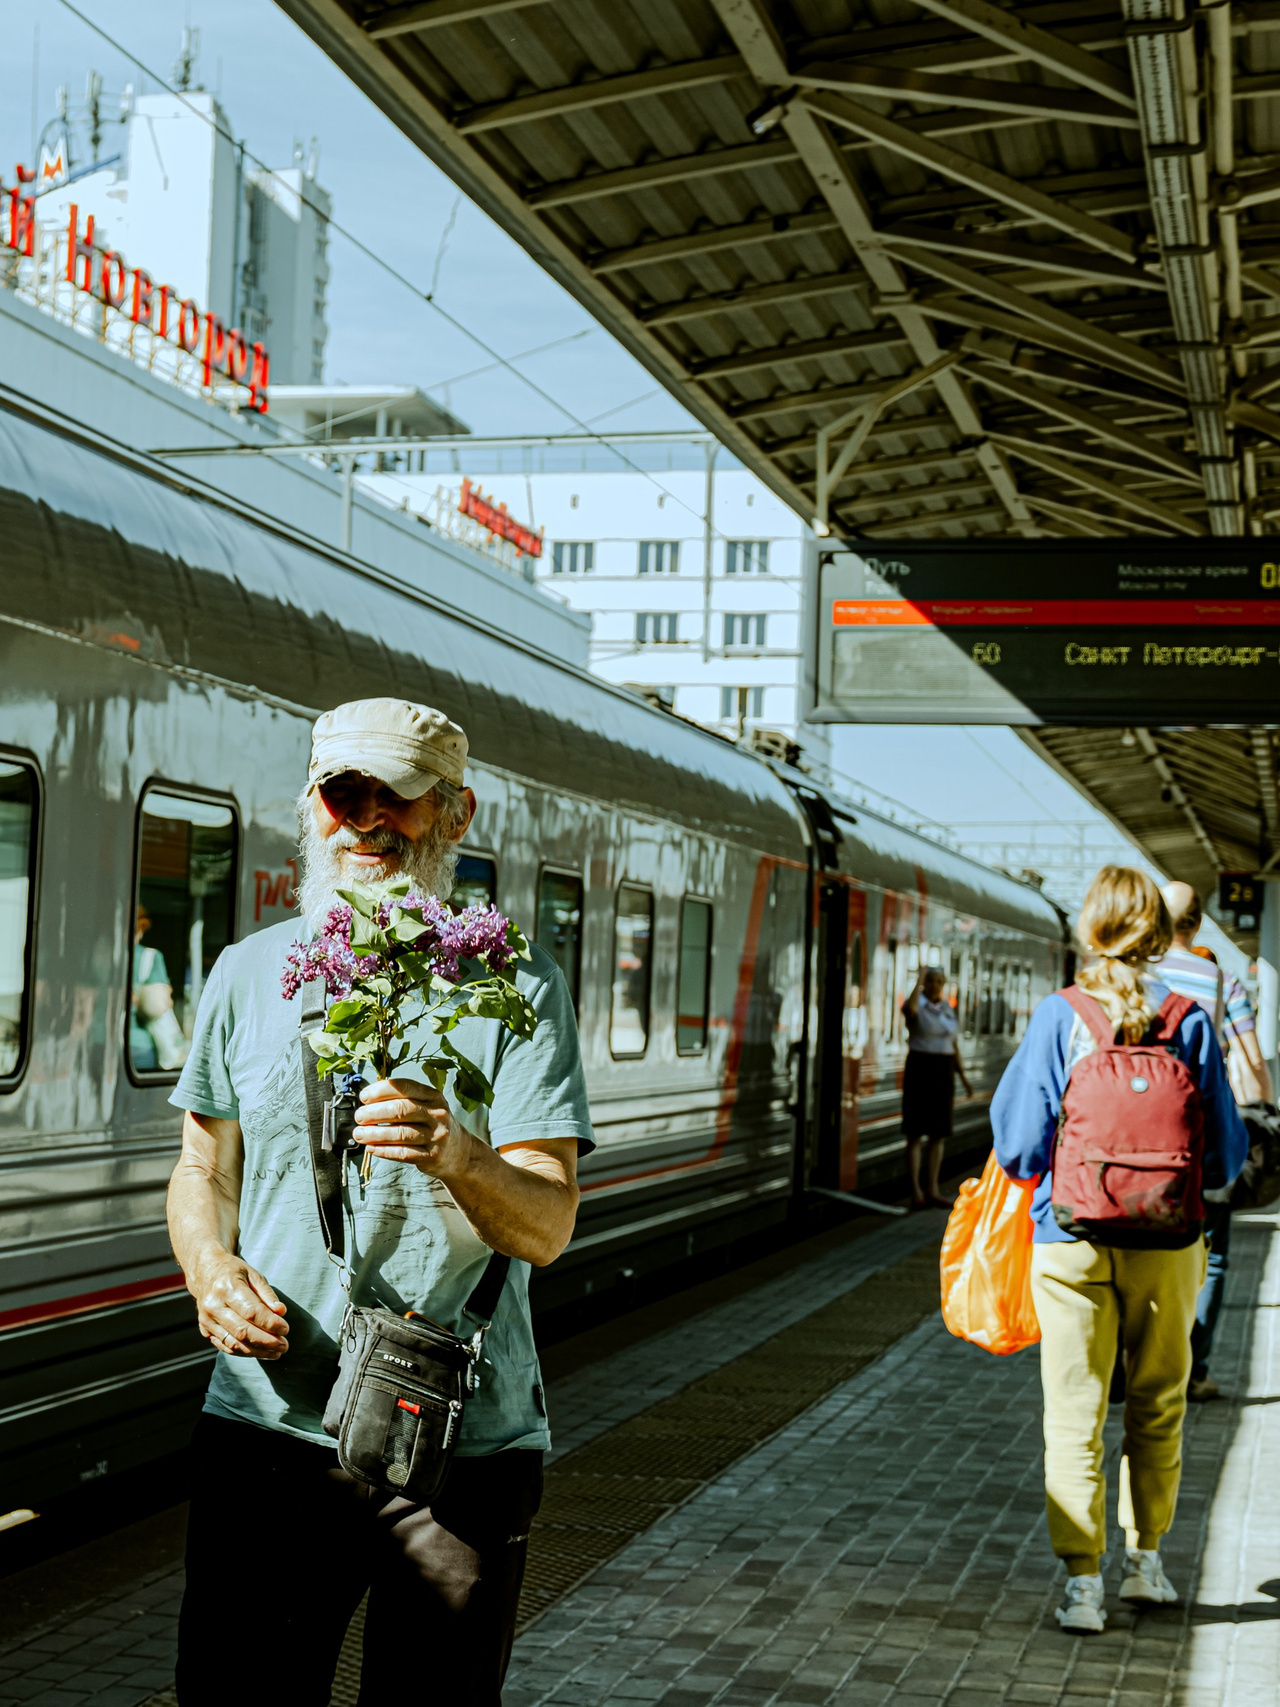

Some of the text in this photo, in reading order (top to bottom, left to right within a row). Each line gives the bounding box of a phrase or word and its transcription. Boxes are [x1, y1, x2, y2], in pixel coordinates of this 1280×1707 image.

[64, 203, 271, 415] Новгород
[863, 557, 911, 578] Путь
[1260, 561, 1280, 589] 0
[972, 642, 1002, 666] 60
[1064, 642, 1133, 666] Санкт
[383, 1354, 413, 1369] SPORT
